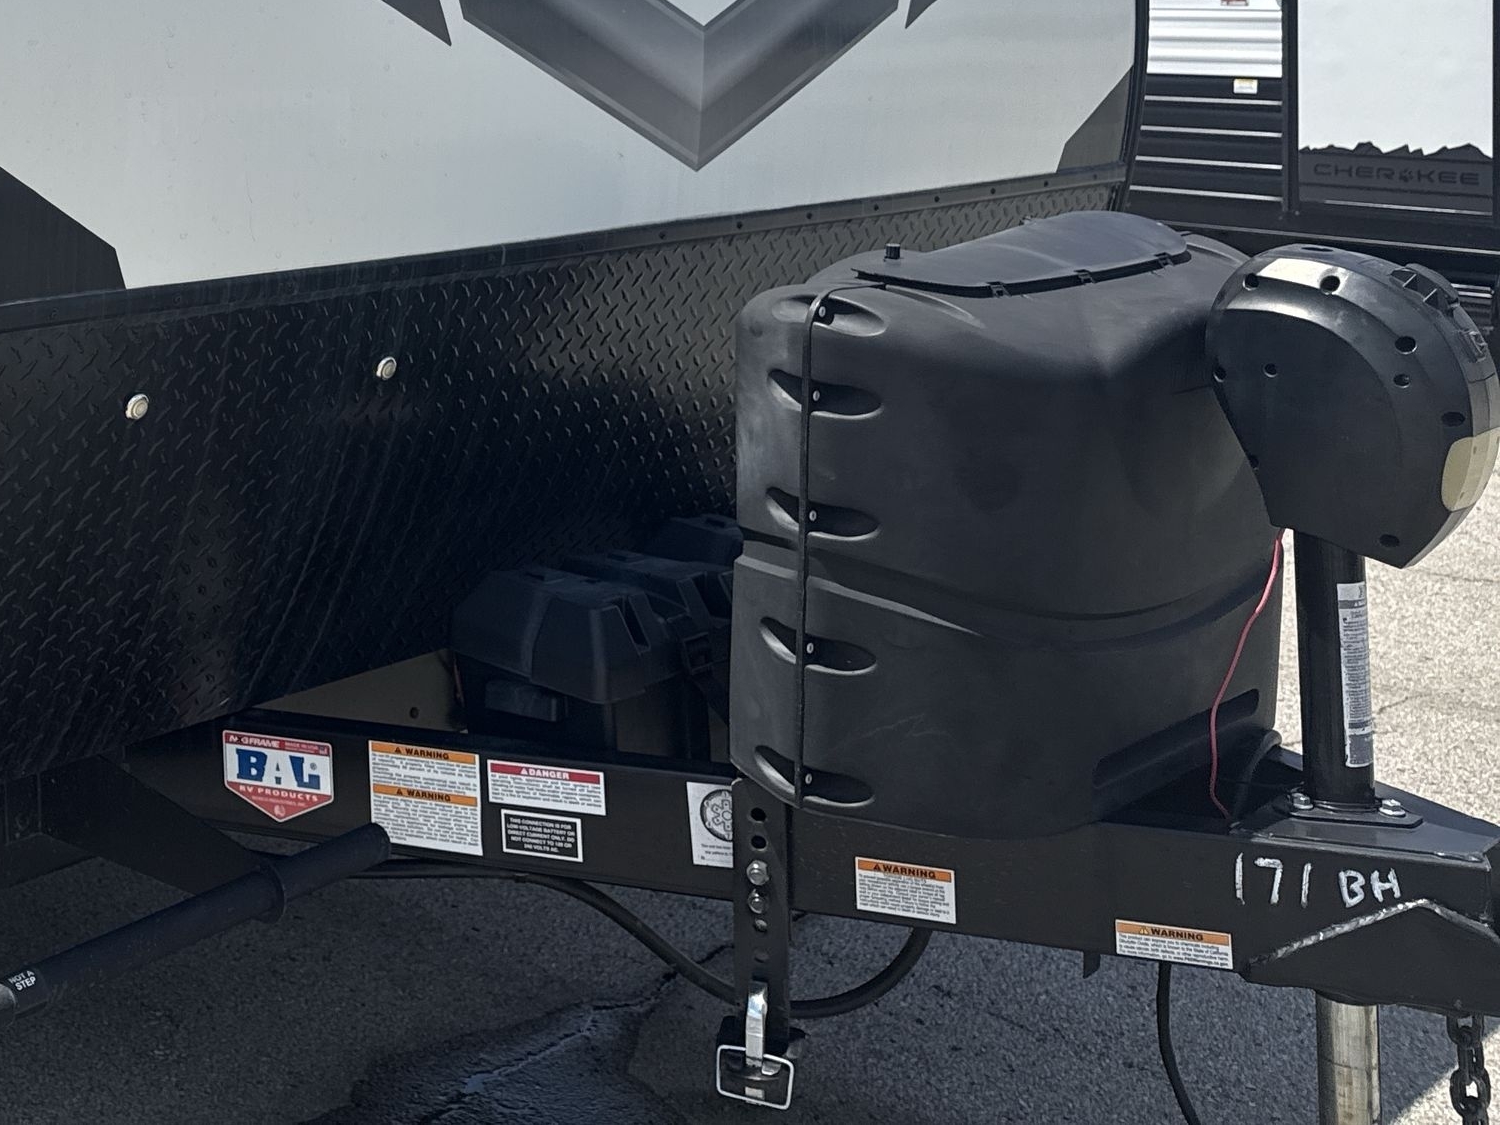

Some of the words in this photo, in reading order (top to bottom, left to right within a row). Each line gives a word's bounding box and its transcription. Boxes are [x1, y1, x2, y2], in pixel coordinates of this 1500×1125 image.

[405, 748, 450, 760] WARNING
[235, 748, 321, 790] BAL
[528, 768, 570, 780] DANGER
[239, 784, 255, 793] RV
[257, 786, 319, 802] PRODUCTS
[407, 789, 451, 802] WARNING
[883, 864, 937, 879] WARNING
[1235, 852, 1313, 909] 171
[1338, 867, 1401, 909] BH
[1150, 928, 1204, 941] WARNING
[8, 972, 26, 984] NOT
[15, 976, 36, 991] STEP
